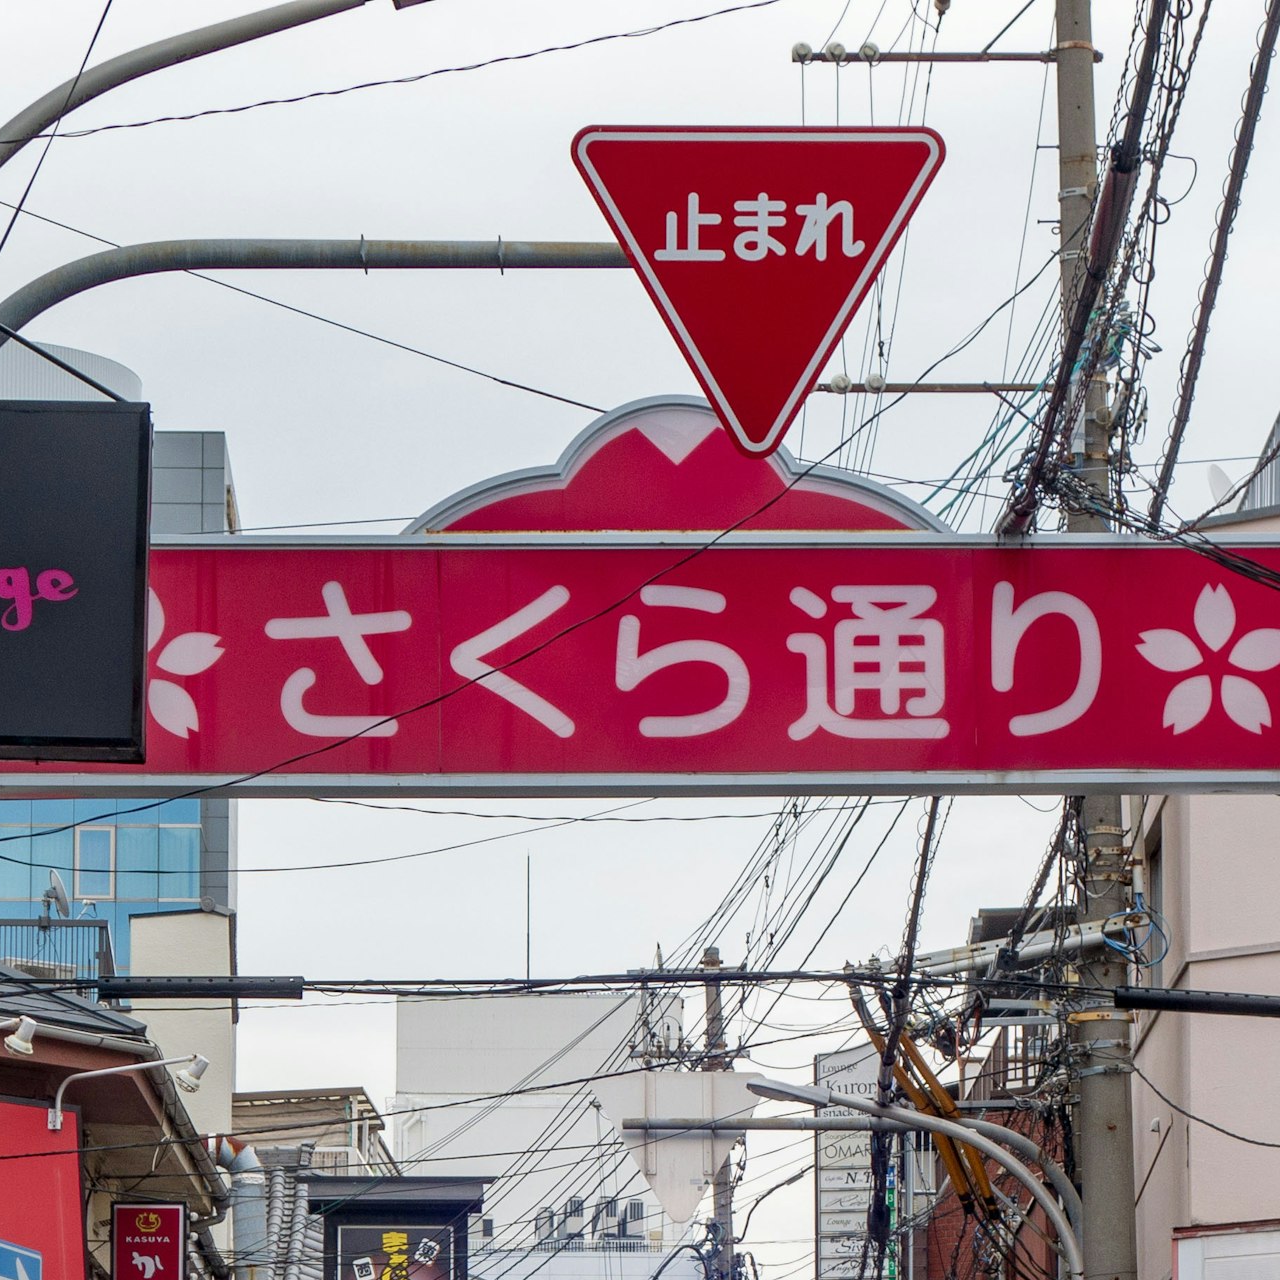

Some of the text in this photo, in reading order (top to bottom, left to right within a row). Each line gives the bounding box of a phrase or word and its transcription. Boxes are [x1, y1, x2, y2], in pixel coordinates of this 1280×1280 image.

[653, 192, 867, 264] 止まれ
[264, 579, 1104, 744] さくら通り
[125, 1235, 171, 1243] KASUYA
